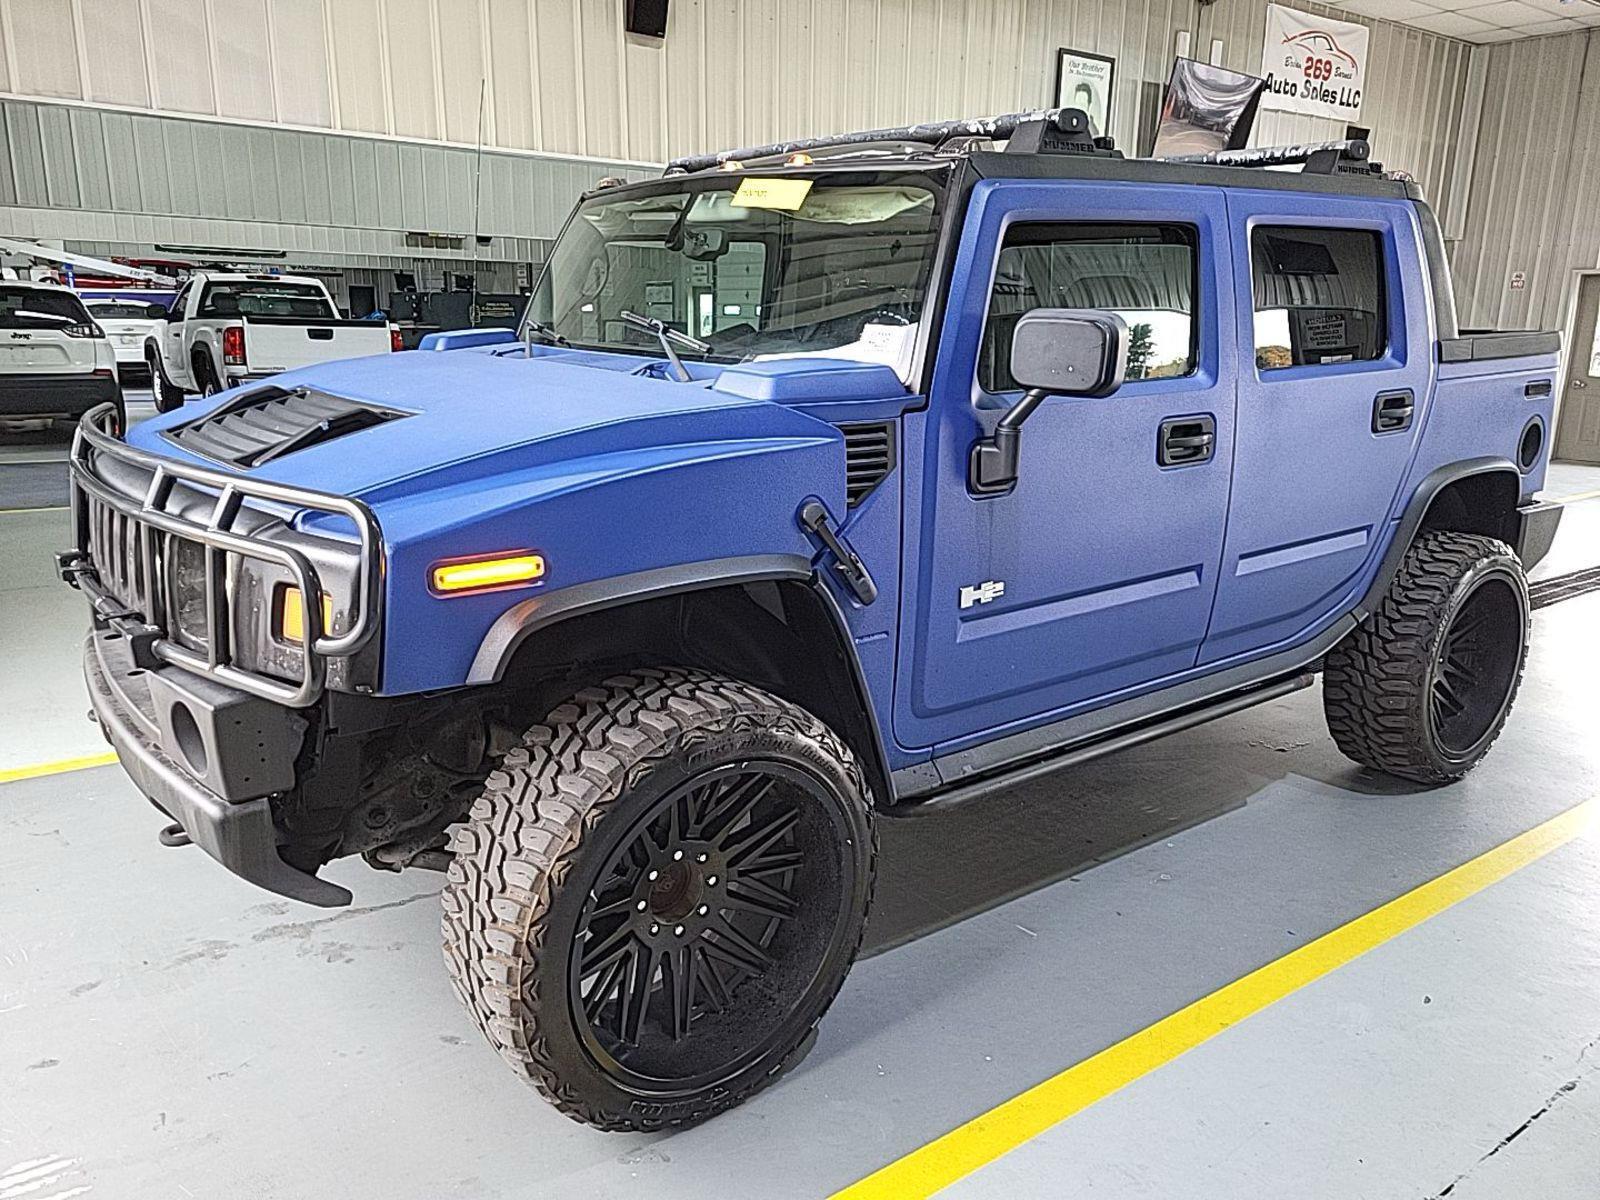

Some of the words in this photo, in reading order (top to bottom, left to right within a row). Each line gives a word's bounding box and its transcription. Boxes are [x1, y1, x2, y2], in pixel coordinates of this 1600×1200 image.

[1303, 56, 1333, 81] 269
[1262, 71, 1298, 97] Auto
[1299, 78, 1338, 104] Sales
[1338, 86, 1361, 109] LLC
[1043, 139, 1095, 153] HUMMER
[959, 580, 1005, 609] H2
